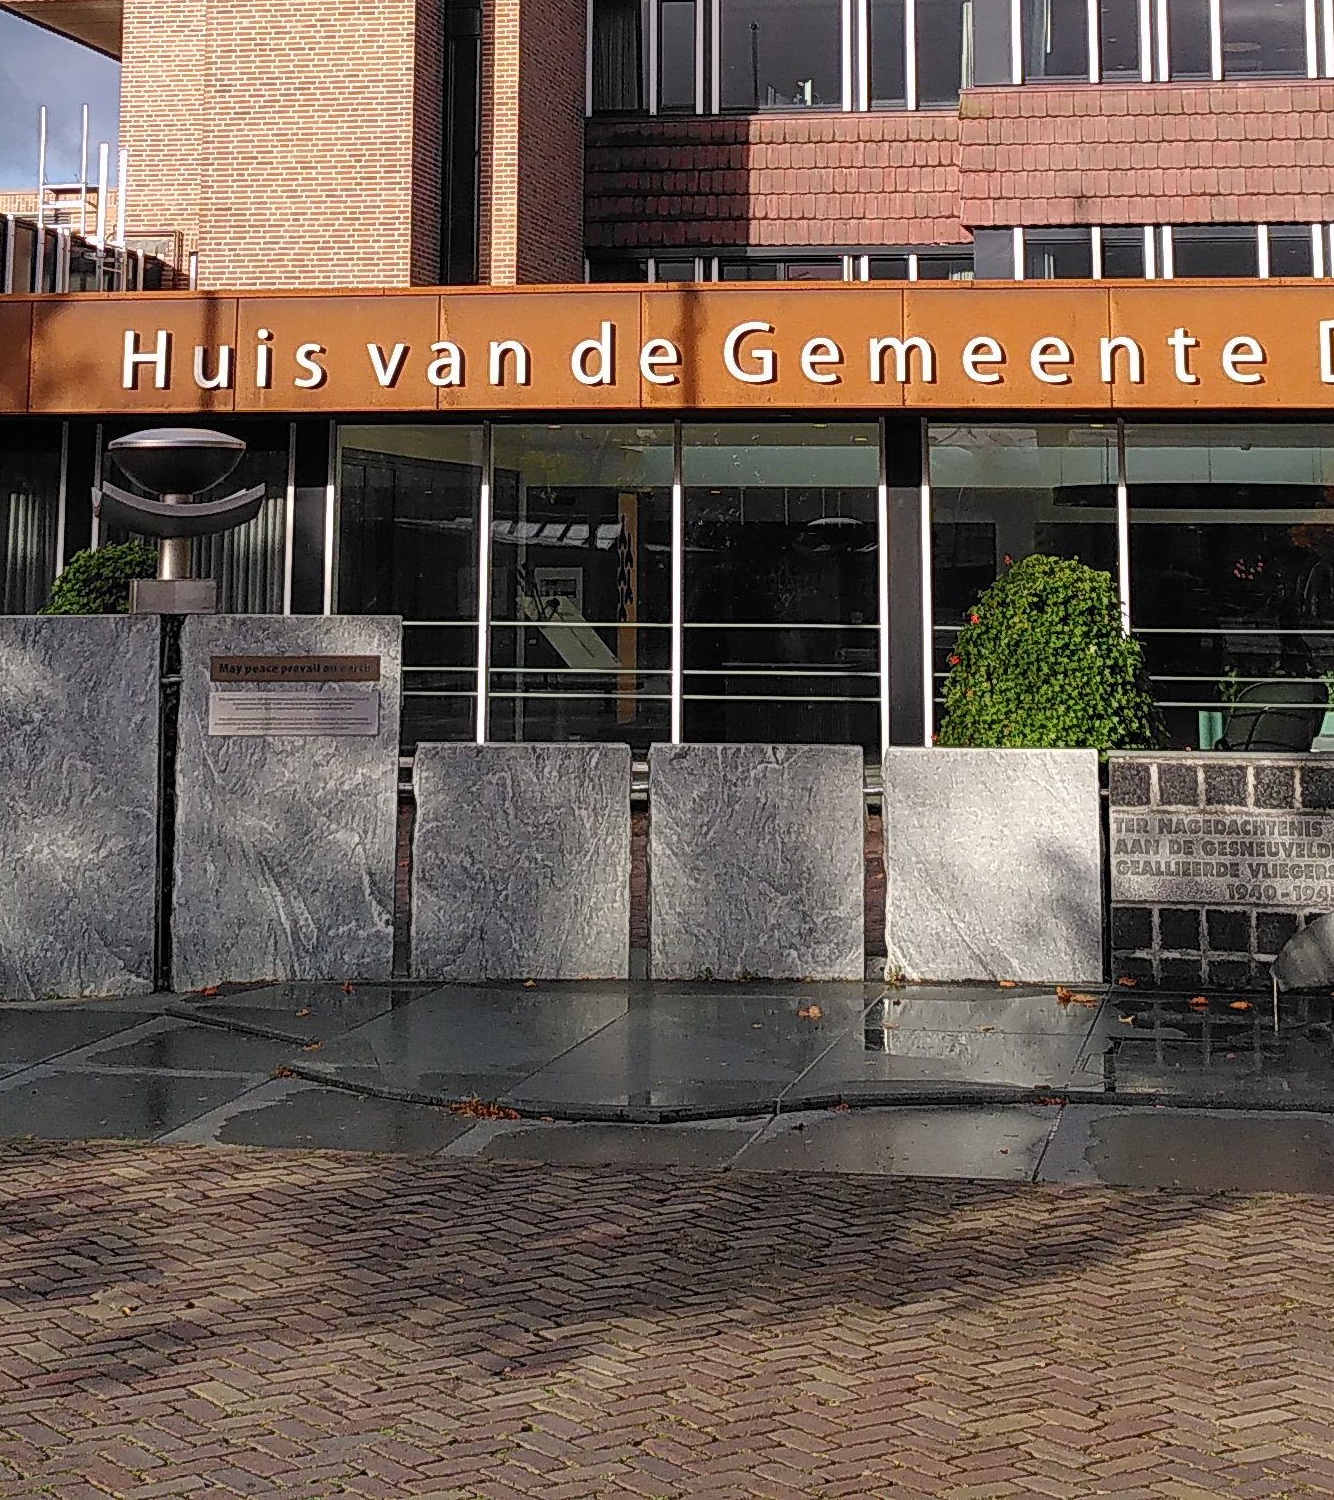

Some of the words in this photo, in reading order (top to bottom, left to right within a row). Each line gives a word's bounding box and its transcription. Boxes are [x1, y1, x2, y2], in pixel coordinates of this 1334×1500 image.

[122, 329, 322, 389] Huis
[366, 341, 527, 386] van
[571, 320, 678, 385] de
[723, 321, 1263, 383] Gemeente
[219, 663, 242, 675] May
[245, 665, 278, 676] peace
[281, 663, 320, 676] prevail
[323, 665, 337, 673] on
[1114, 817, 1149, 834] TER
[1158, 818, 1323, 837] NAGEDACHTENIS
[1114, 839, 1160, 855] AAN
[1169, 840, 1193, 856] DE
[1116, 860, 1240, 878] GEALLIEERDE
